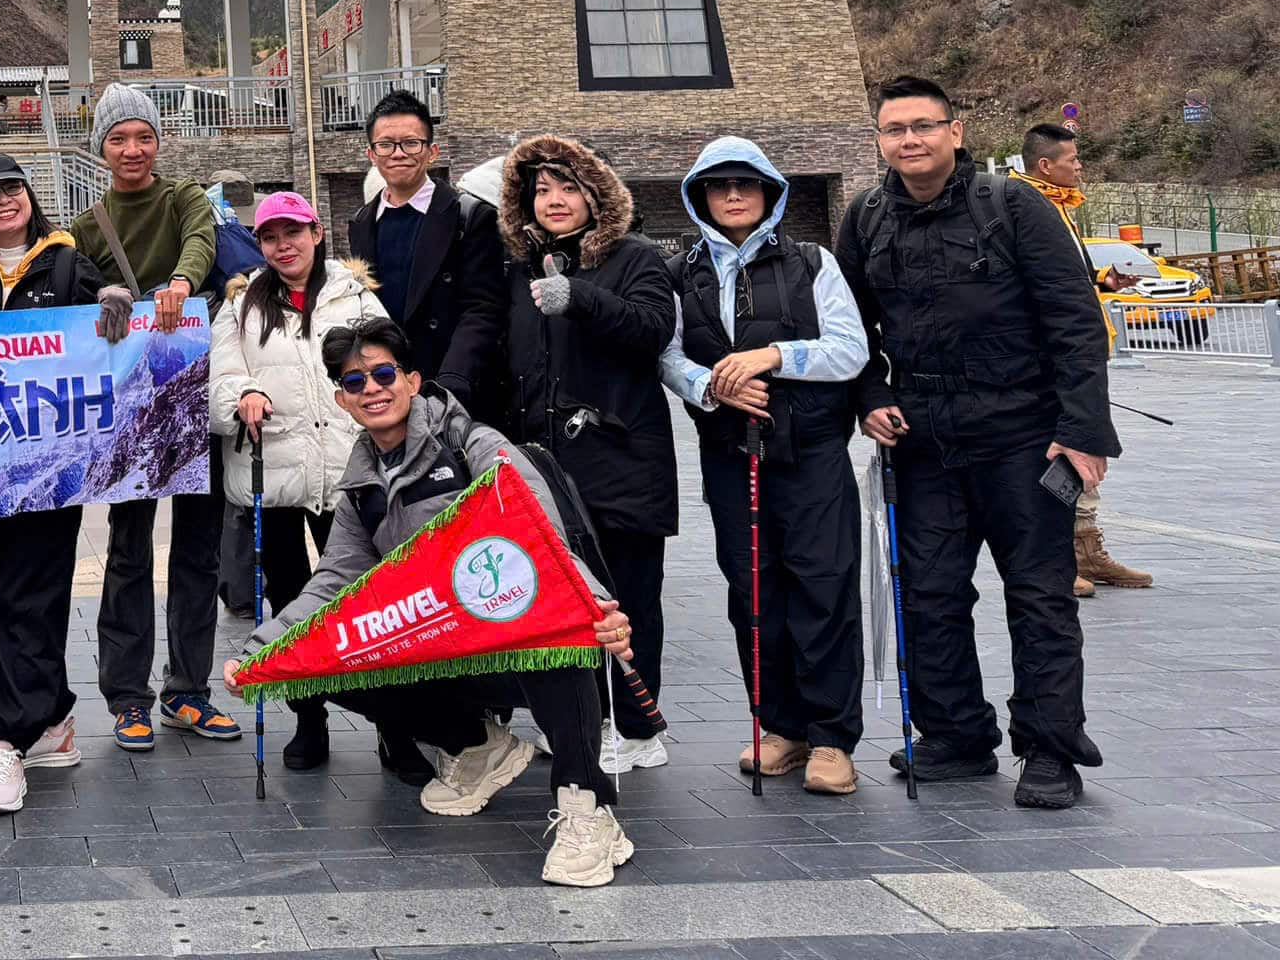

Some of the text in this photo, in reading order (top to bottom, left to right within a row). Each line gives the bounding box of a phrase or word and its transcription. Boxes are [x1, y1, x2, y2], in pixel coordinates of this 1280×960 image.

[335, 586, 449, 651] J TRAVEL
[482, 585, 528, 611] TRAVEL
